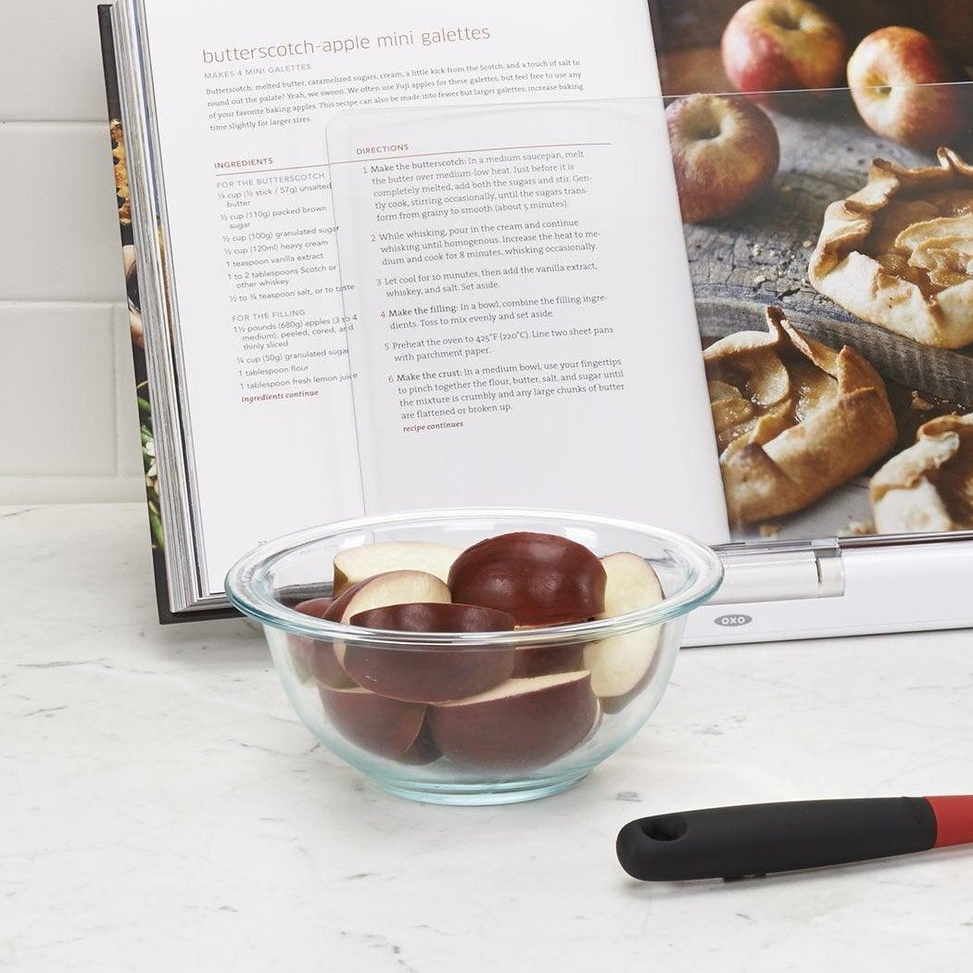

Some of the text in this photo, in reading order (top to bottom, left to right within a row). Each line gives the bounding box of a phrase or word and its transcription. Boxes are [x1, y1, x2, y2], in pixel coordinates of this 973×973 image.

[202, 27, 490, 63] butterscotch-apple mini galettes
[203, 70, 235, 78] MAKES
[267, 64, 312, 73] GALETTES
[356, 144, 409, 155] DIRECTIONS
[214, 158, 273, 169] INGREDIENTS
[363, 166, 368, 174] 1
[370, 164, 395, 173] Make
[394, 162, 411, 171] the
[467, 157, 477, 165] In
[484, 154, 522, 163] medium
[564, 150, 584, 159] melt
[235, 179, 254, 187] THE
[255, 173, 328, 185] BUTTERSCOTCH
[245, 210, 271, 219] (110g)
[271, 206, 301, 218] packed
[229, 222, 251, 231] sugar
[377, 230, 405, 240] While
[448, 228, 469, 237] pour
[469, 224, 480, 233] in
[479, 224, 496, 232] the
[522, 220, 541, 230] and
[541, 220, 578, 229] continue
[232, 258, 270, 267] teaspoon
[270, 255, 295, 263] vanilla
[296, 253, 324, 261] extract
[227, 272, 231, 280] 1
[251, 269, 300, 278] tablespoons
[299, 264, 327, 274] Scotch
[235, 278, 290, 288] other whiskey
[423, 284, 442, 294] and
[460, 282, 475, 291] Set
[231, 314, 250, 322] FOR
[271, 310, 306, 318] FILLING
[418, 318, 439, 326] Toss
[449, 315, 468, 324] mix
[468, 313, 497, 323] evenly
[497, 311, 516, 320] and
[514, 311, 529, 319] set
[393, 351, 416, 361] with
[414, 348, 464, 362] parchment
[244, 367, 290, 376] tablespoon
[290, 364, 309, 372] flour
[396, 373, 421, 381] Make
[421, 371, 437, 379] the
[462, 368, 473, 376] In
[480, 364, 519, 374] medium
[559, 362, 579, 372] your
[580, 358, 621, 370] fingertips
[398, 385, 407, 394] to
[408, 382, 434, 396] pinch
[433, 380, 472, 392] together
[471, 378, 488, 387] the
[560, 371, 577, 381] and
[576, 373, 602, 382] sugar
[602, 369, 624, 378] until
[240, 390, 319, 403] ingredients continue
[399, 382, 624, 406] the mixture is crumbly and any large chunks of butter
[415, 406, 456, 418] flattened
[467, 404, 498, 413] broken
[402, 421, 464, 433] recipe continues
[721, 616, 745, 625] OXO
